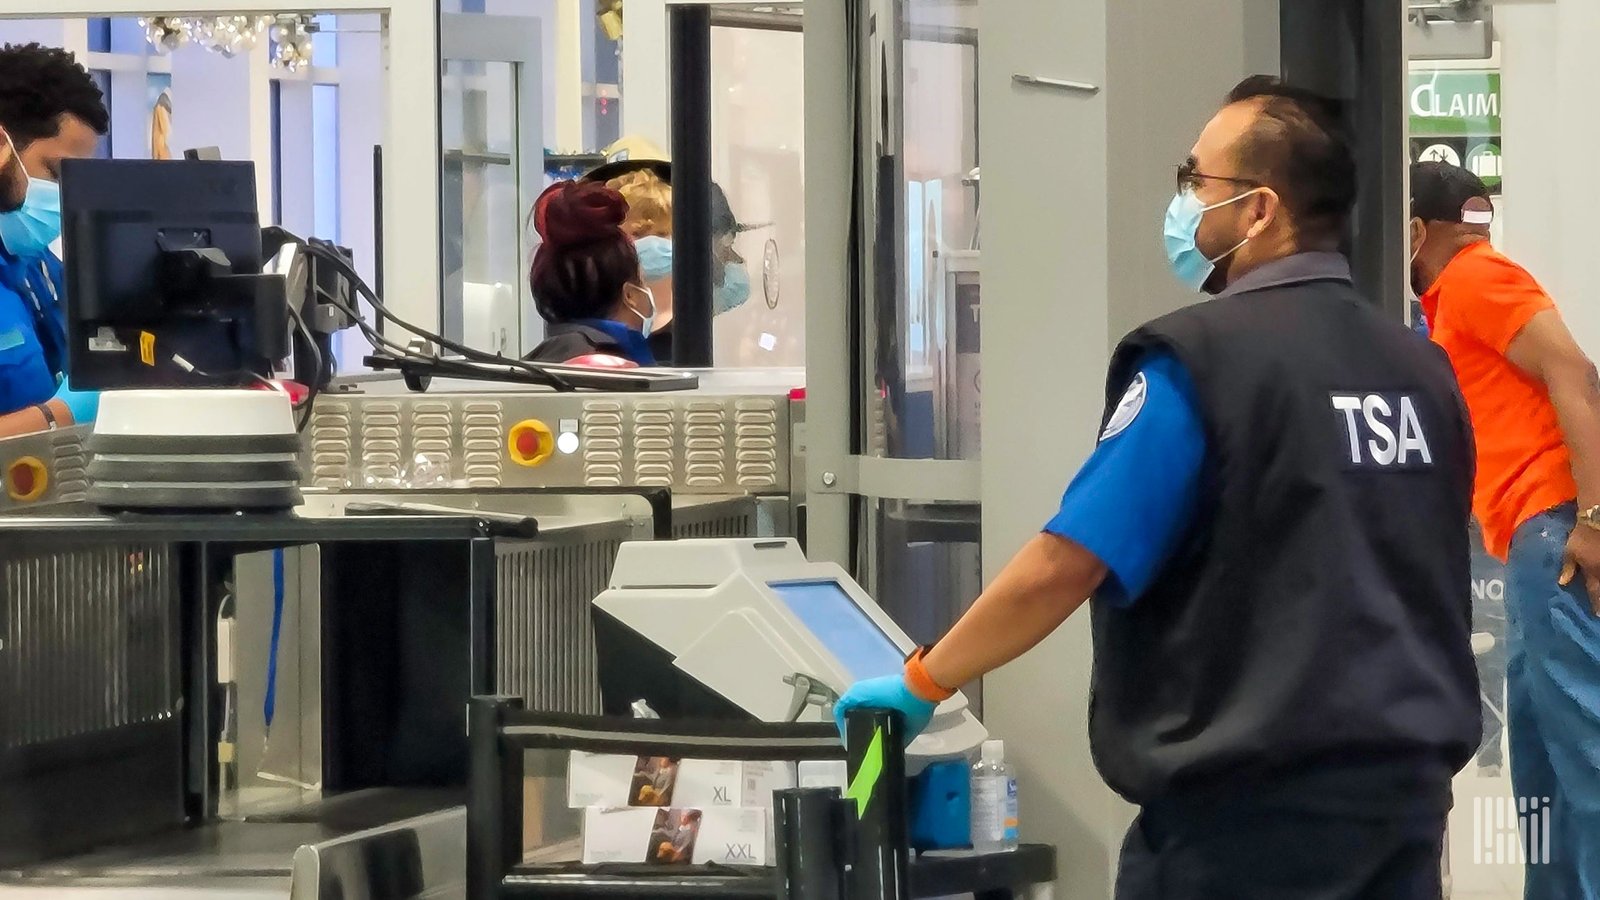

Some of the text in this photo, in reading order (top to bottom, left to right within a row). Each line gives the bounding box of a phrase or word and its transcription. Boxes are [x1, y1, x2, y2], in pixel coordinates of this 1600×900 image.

[1331, 394, 1432, 465] TSA
[713, 786, 732, 802] XL
[725, 843, 757, 860] XXL
